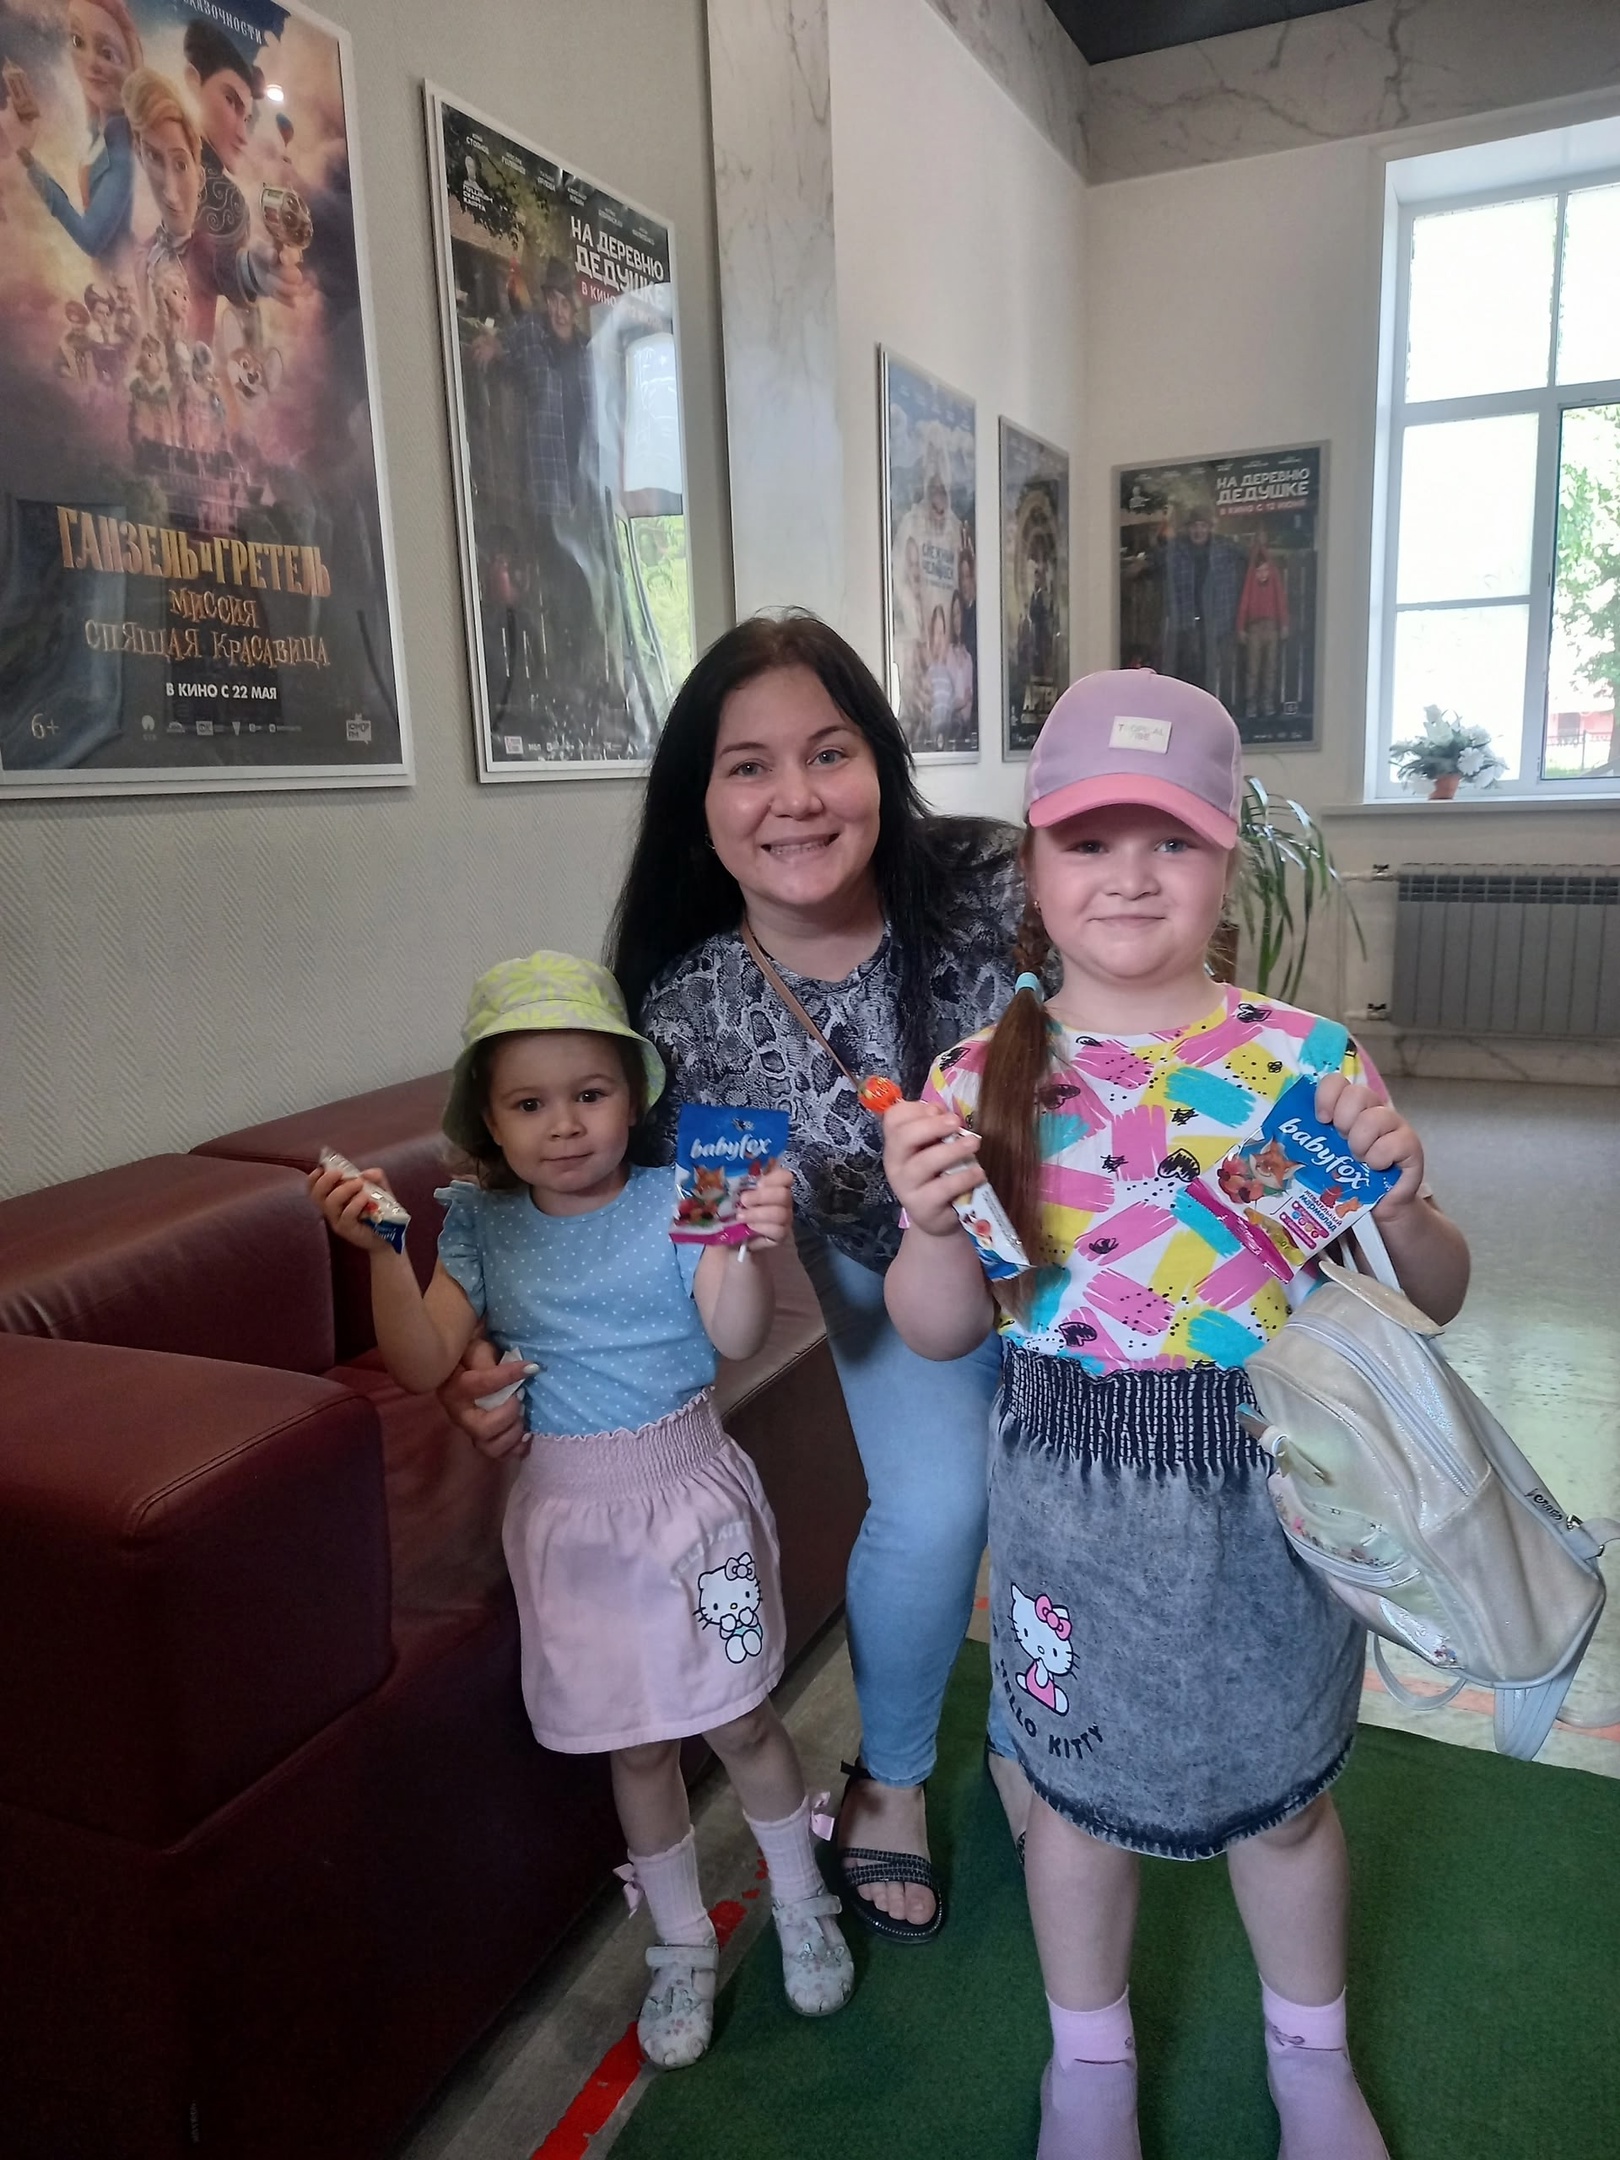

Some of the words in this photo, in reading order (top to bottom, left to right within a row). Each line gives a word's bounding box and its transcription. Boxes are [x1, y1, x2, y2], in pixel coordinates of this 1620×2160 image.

[183, 0, 262, 44] КАЗОЧНОСТИ
[570, 215, 594, 247] НА
[597, 230, 664, 281] ДЕРЕВНЮ
[581, 281, 588, 295] В
[590, 285, 616, 308] КИНО
[1216, 481, 1309, 506] ДЕДУШКЕ
[1217, 476, 1237, 490] НА
[1240, 467, 1310, 487] ДЕРЕВНЮ
[57, 505, 199, 580] ГАНЗЕЛЬ
[213, 536, 331, 597] ГРЕТЕЛЬ
[168, 587, 260, 629] МИССИЯ
[84, 619, 202, 663] СПЯЩАЯ
[166, 682, 174, 696] В
[178, 683, 218, 697] КИНО
[221, 685, 229, 698] С
[232, 685, 248, 699] 22
[251, 686, 277, 700] МАЯ
[31, 713, 59, 739] 6+
[690, 1134, 772, 1161] babyfox
[1278, 1118, 1370, 1190] babyfox
[1048, 1722, 1104, 1760] KITTY
